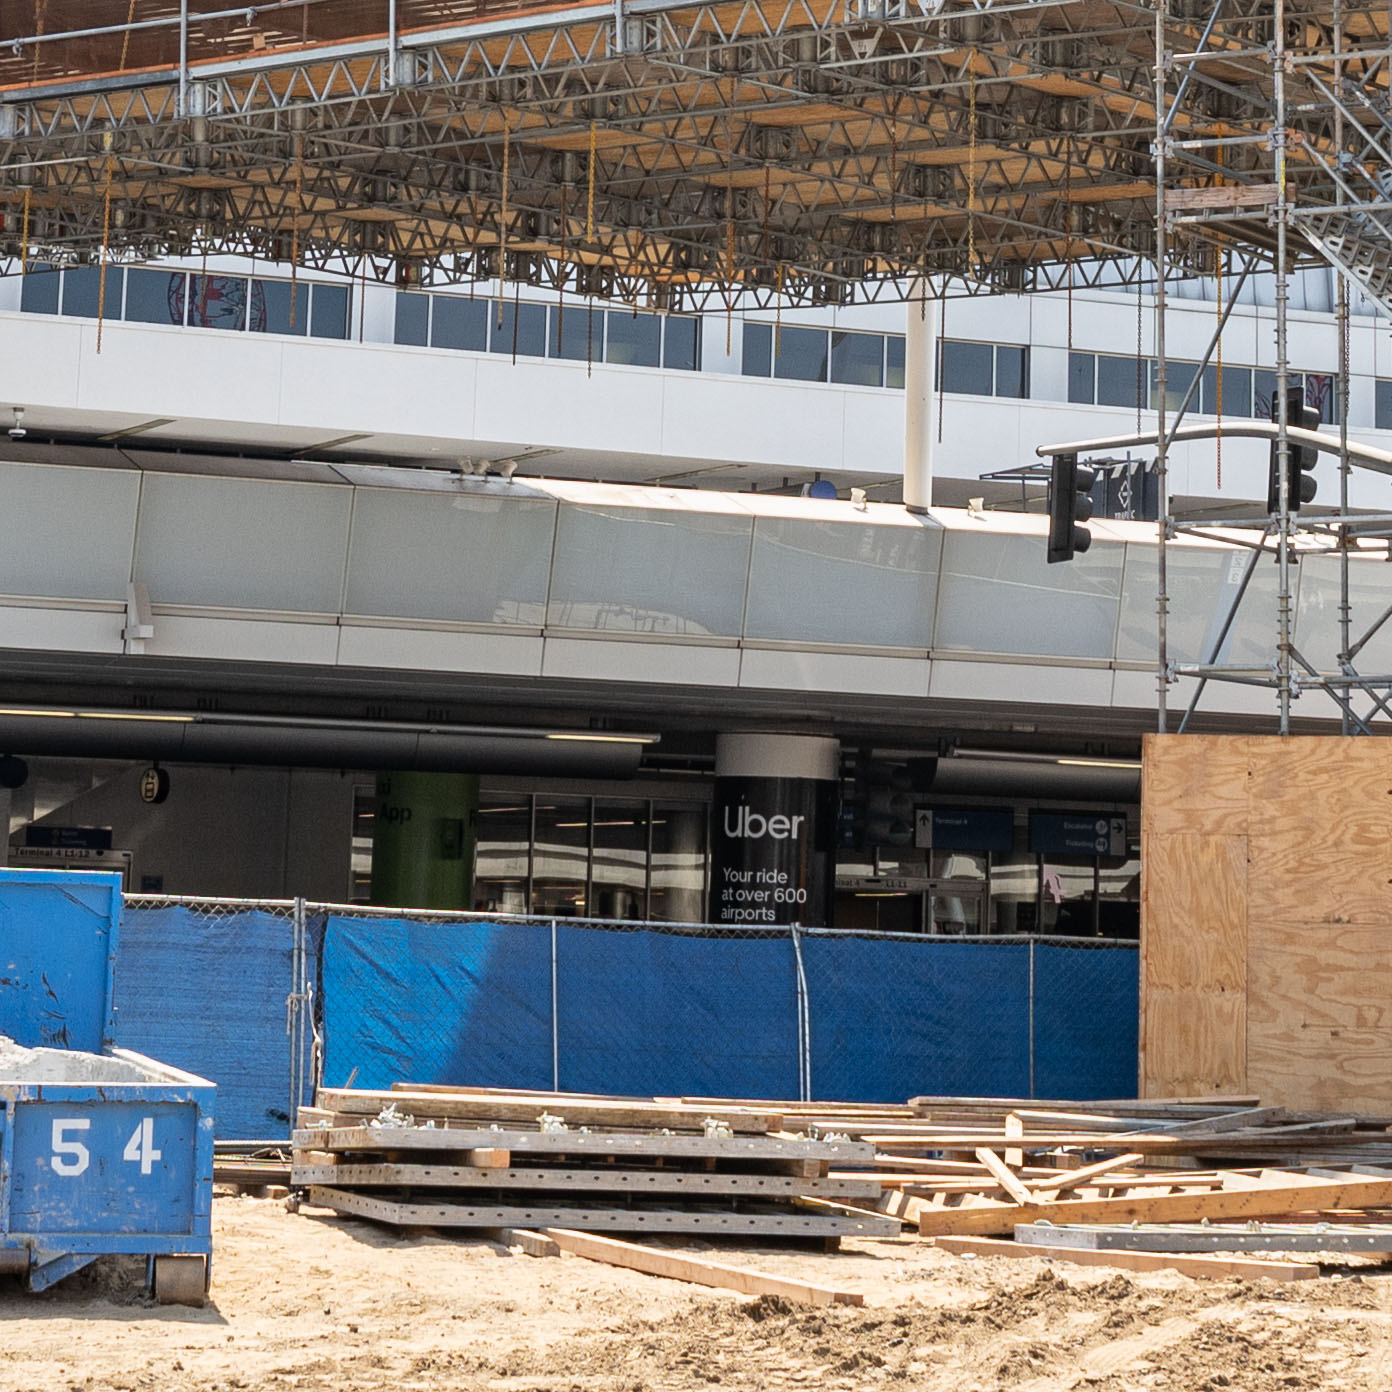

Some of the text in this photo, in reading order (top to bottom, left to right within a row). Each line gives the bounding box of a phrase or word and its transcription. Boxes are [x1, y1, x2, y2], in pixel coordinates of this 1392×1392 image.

[724, 806, 805, 840] Uber
[15, 848, 54, 857] Terminal
[723, 867, 789, 884] Your ride
[721, 887, 807, 903] at over 600
[721, 904, 776, 923] airports
